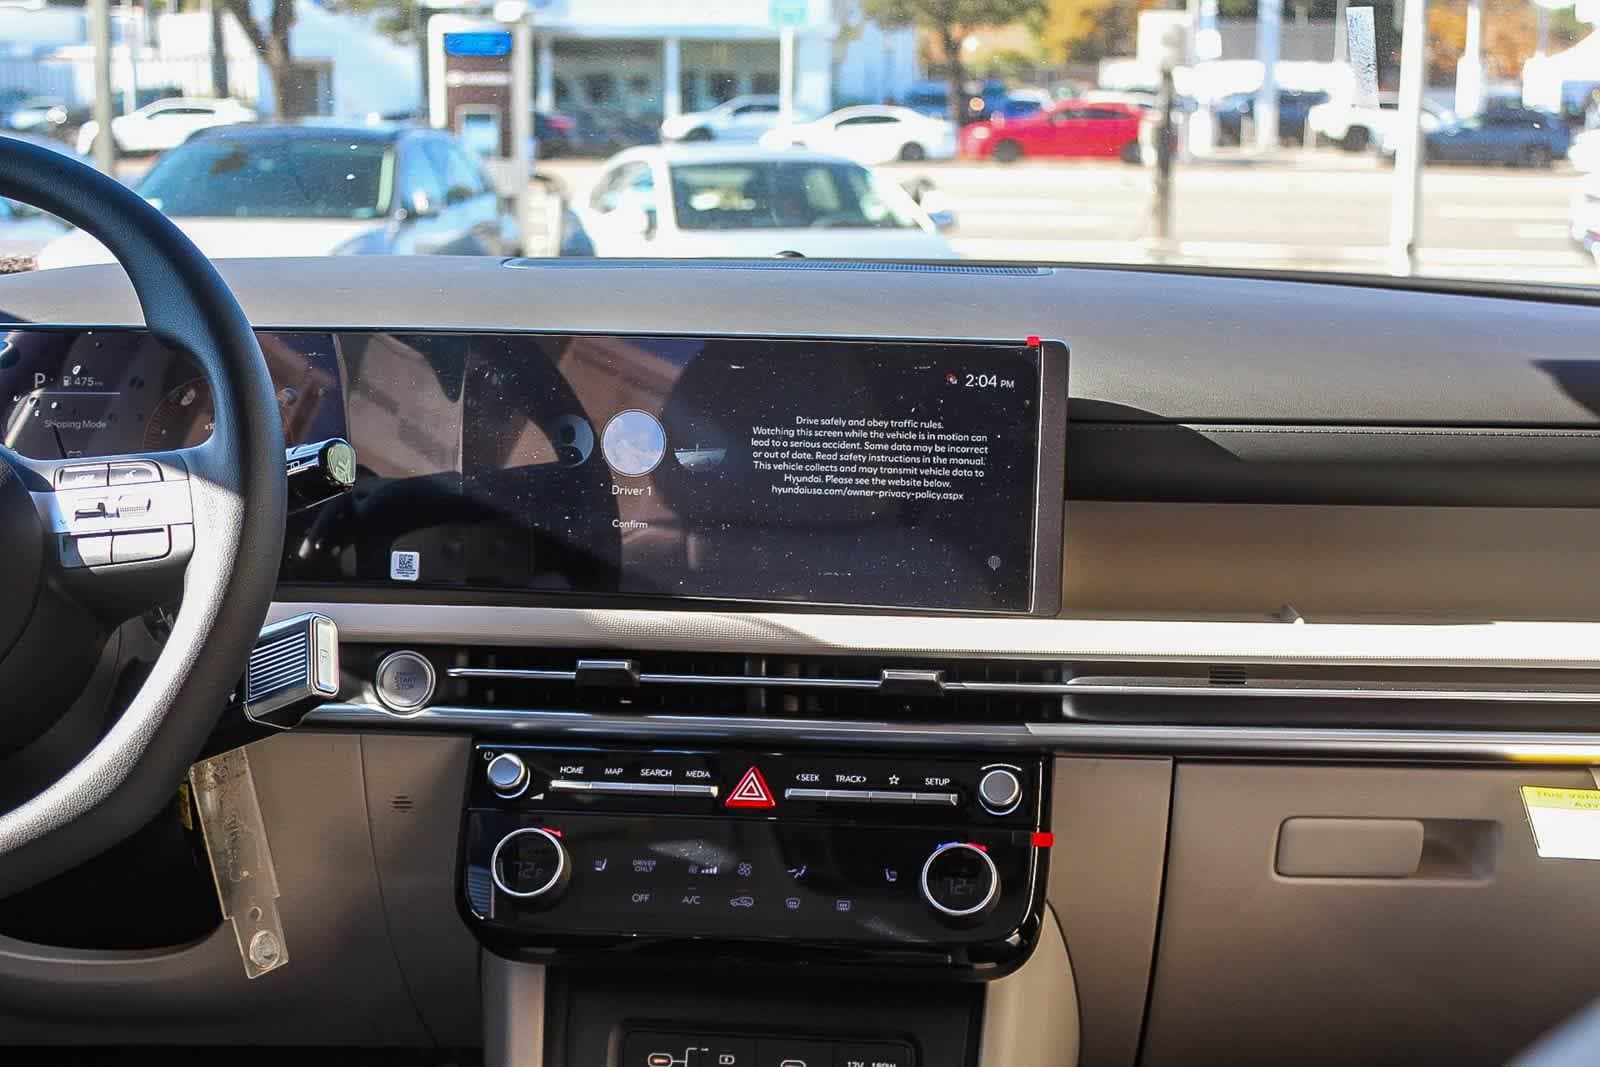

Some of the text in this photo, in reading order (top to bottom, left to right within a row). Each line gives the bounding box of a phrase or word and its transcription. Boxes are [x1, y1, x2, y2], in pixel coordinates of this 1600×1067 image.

[74, 377, 94, 386] 475
[965, 374, 1015, 388] 2:04 PM
[796, 416, 944, 430] Drive safely and obey traffic rules.
[753, 426, 794, 438] Watching
[796, 427, 813, 437] this
[814, 430, 843, 438] screen
[845, 428, 868, 438] while
[869, 430, 885, 439] the
[886, 430, 917, 440] vehicle
[919, 432, 926, 441] is
[927, 432, 935, 441] in
[937, 432, 969, 441] motion
[751, 438, 769, 447] lead
[771, 439, 781, 448] to
[790, 440, 820, 449] serious
[822, 440, 863, 450] accident.
[864, 441, 889, 451] Some
[890, 442, 912, 452] data
[913, 445, 933, 454] may
[934, 444, 946, 453] be
[948, 445, 988, 454] incorrect
[764, 451, 779, 459] out
[780, 450, 790, 459] of
[791, 451, 814, 460] date.
[815, 451, 838, 461] Read
[839, 452, 866, 463] safety
[868, 453, 920, 464] instructions
[922, 455, 931, 464] in
[932, 456, 948, 465] the
[949, 457, 985, 466] manual.
[753, 460, 984, 478] This vehicle collects and may transmit vehicle data to
[784, 473, 824, 486] Hyundai.
[825, 474, 853, 485] Please
[871, 476, 886, 486] the
[887, 477, 921, 487] website
[923, 478, 951, 488] below.
[612, 484, 652, 496] Driver 1
[771, 485, 964, 500] hyundaiusa.com/owner-privacy-policy.aspx
[612, 520, 648, 528] Confirm
[560, 766, 584, 774] HOME
[604, 768, 623, 776] MAP
[640, 768, 672, 777] SEARCH
[686, 770, 710, 778] MEDIA
[925, 777, 950, 786] SETUP
[632, 893, 650, 902] OFF
[682, 896, 700, 904] A/C
